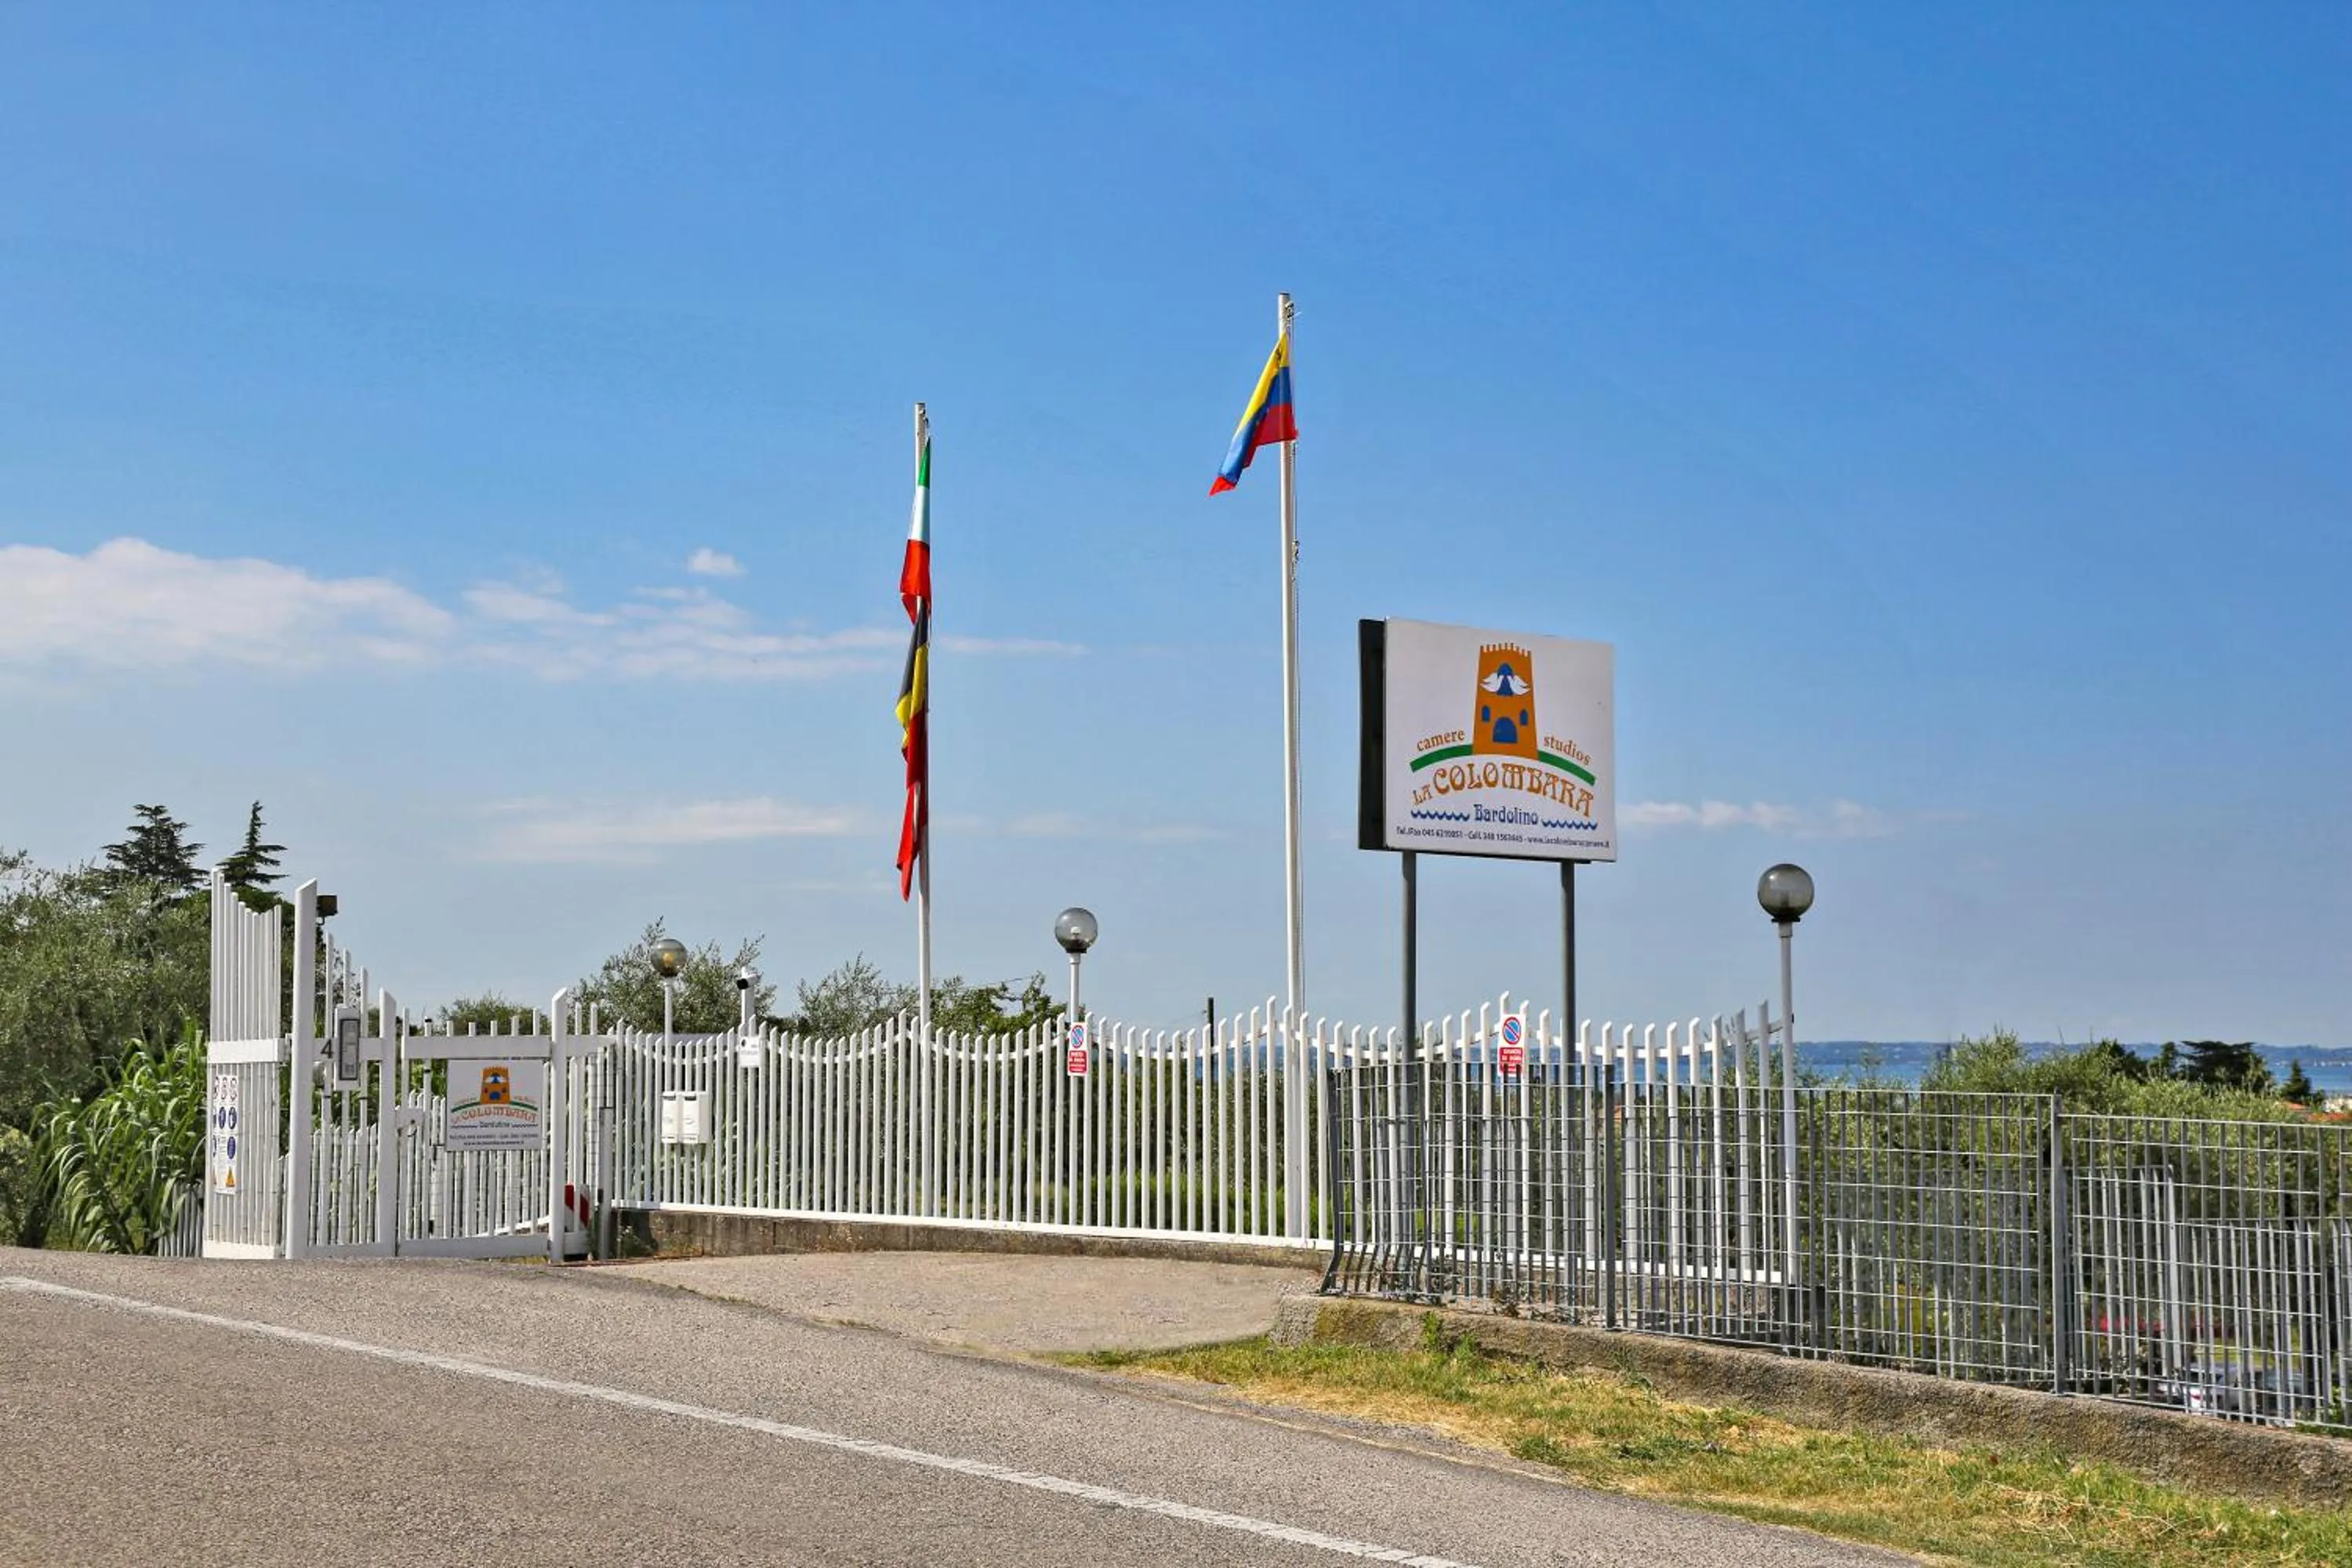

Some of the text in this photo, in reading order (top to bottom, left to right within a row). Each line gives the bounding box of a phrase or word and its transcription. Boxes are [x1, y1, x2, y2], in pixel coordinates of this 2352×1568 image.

[1416, 729, 1592, 766] camere studios
[1412, 761, 1595, 818] LA COLOMBARA
[1473, 804, 1540, 825] Bardolino
[320, 1039, 334, 1059] 4
